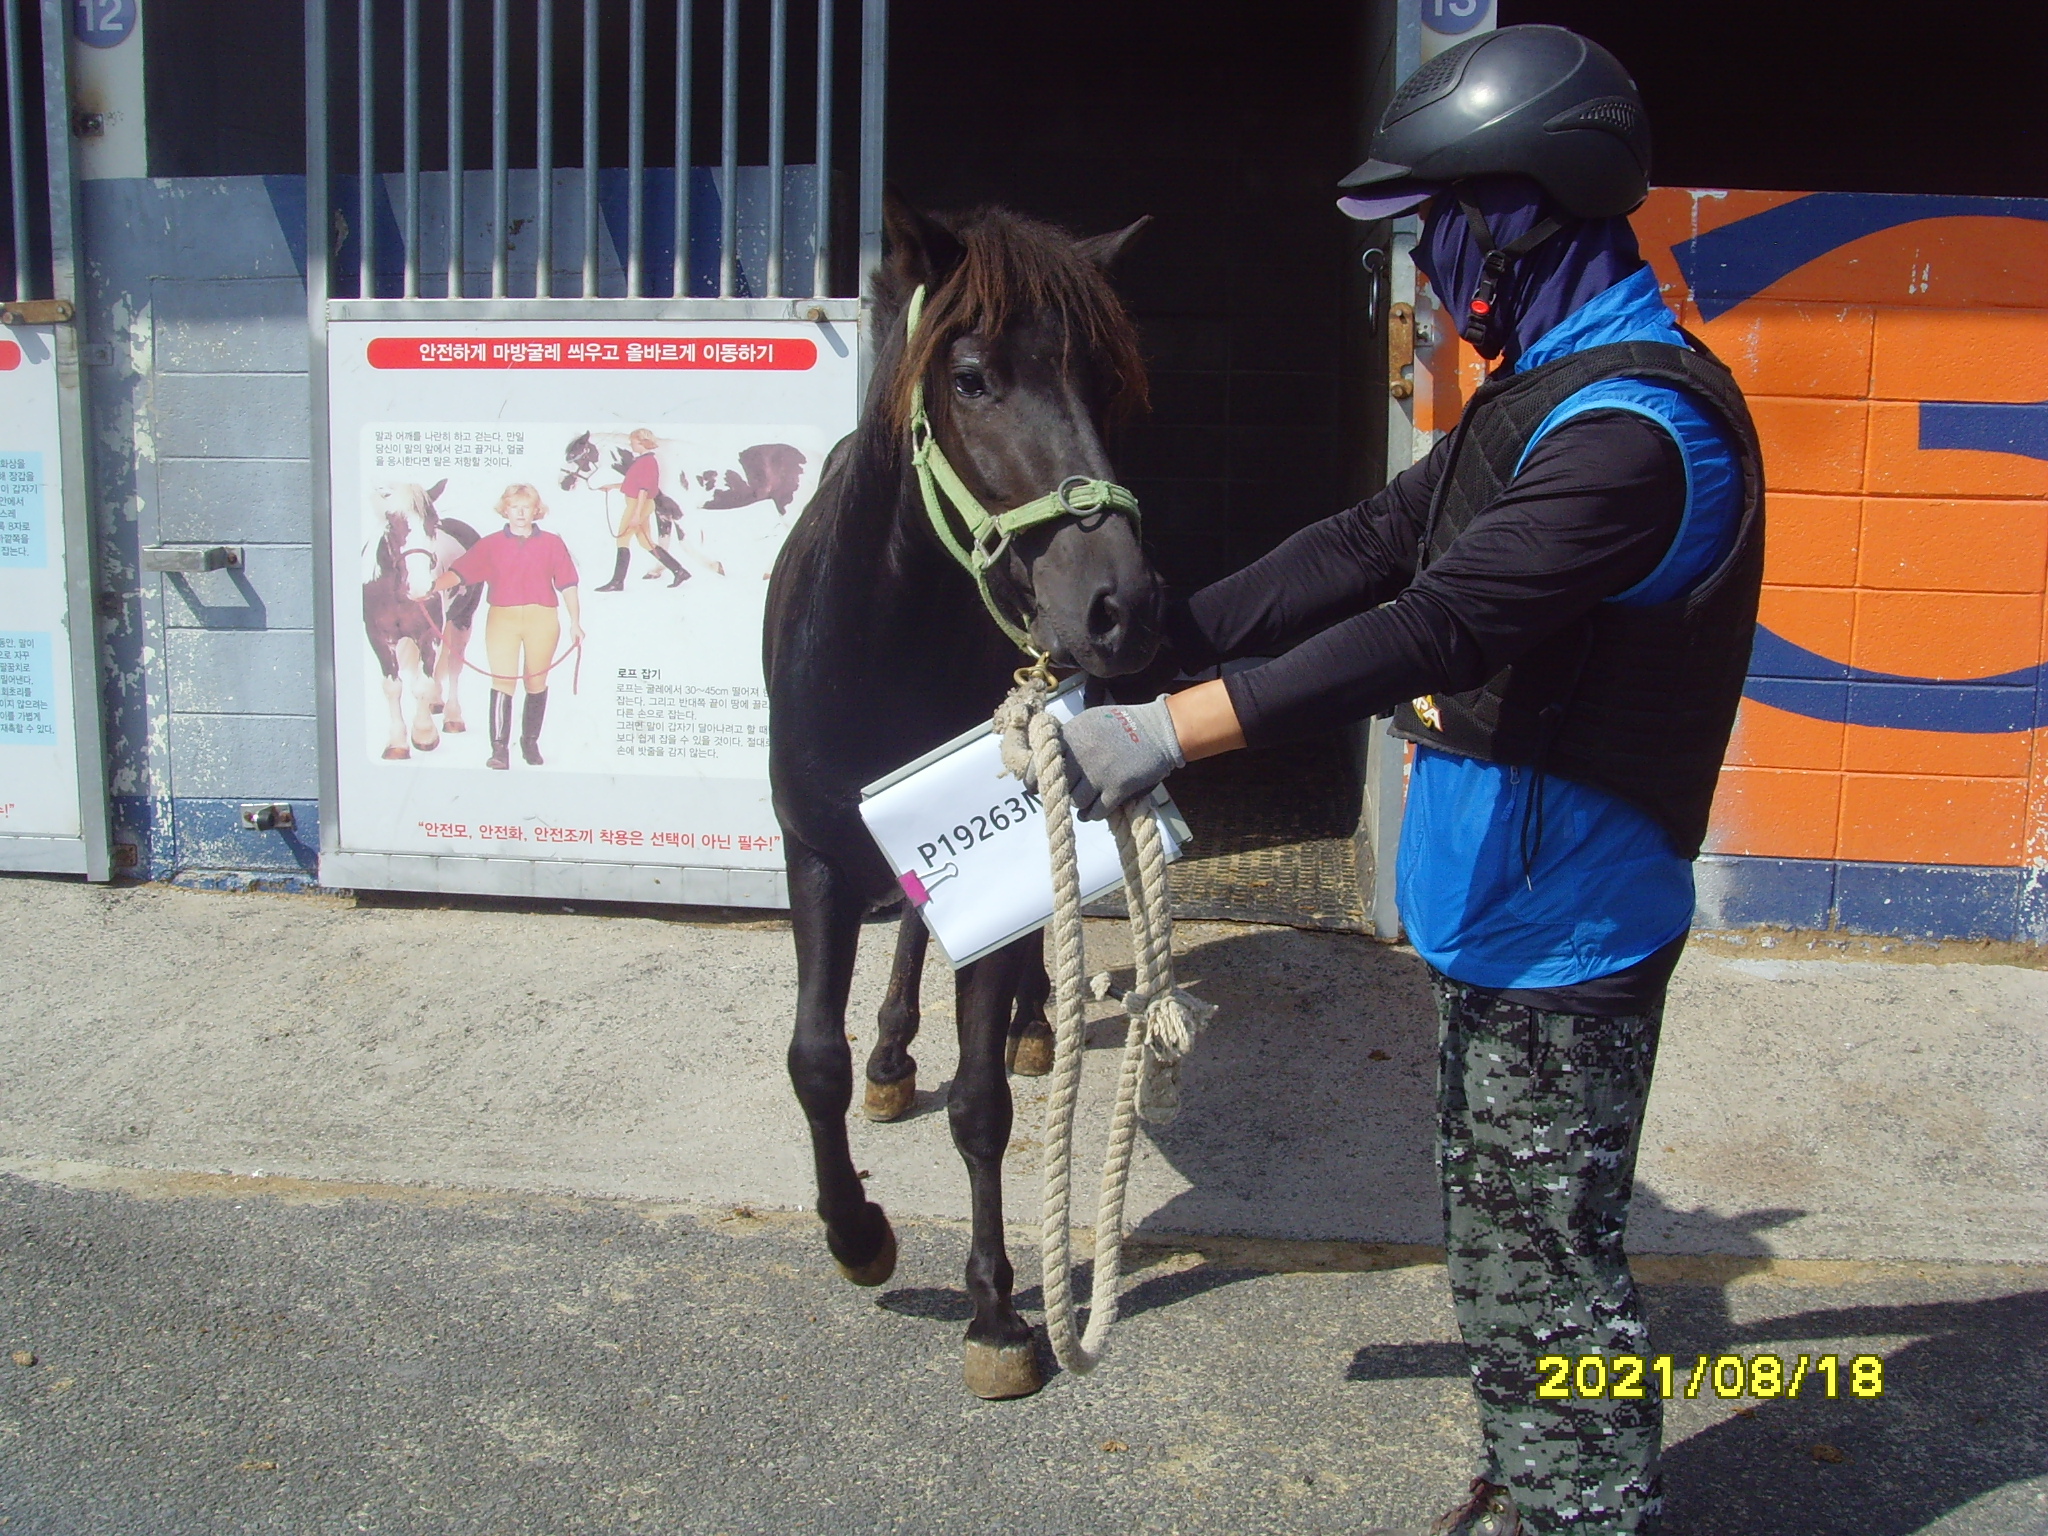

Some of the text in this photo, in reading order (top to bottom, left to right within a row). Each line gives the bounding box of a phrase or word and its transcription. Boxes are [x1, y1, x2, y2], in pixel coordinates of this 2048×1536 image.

[79, 0, 123, 31] 12
[419, 343, 774, 362] 안전하게 마방굴레 씌우고 올바르게 이동하기
[375, 431, 392, 441] 말과
[396, 431, 421, 441] 어깨를
[425, 431, 450, 441] 나란히
[454, 431, 471, 441] 하고
[506, 431, 524, 441] 만일
[375, 444, 401, 454] 당신이
[404, 444, 422, 454] 말의
[425, 444, 450, 454] 앞에서
[454, 444, 471, 454] 걷고
[506, 444, 524, 454] 얼굴
[376, 456, 512, 466] 을 응시한다면 말은 저항할 것이다.
[9, 472, 34, 481] 장갑을
[12, 484, 37, 494] 갑자기
[19, 638, 34, 648] 말이
[14, 651, 29, 660] 자꾸
[618, 668, 661, 680] 로프 잡기
[1, 687, 32, 697] 회초리를
[616, 683, 643, 693] 로프는
[646, 684, 682, 695] 굴레에서
[732, 687, 759, 696] 떨어져
[17, 700, 48, 710] 않으려는
[616, 696, 645, 706] 잡는다.
[649, 697, 675, 706] 그리고
[679, 697, 706, 708] 반대쪽
[709, 698, 727, 708] 끝이
[731, 700, 748, 709] 땅에
[18, 712, 41, 722] 가볍게
[616, 708, 696, 720] 다른 손으로 잡는다.
[26, 724, 34, 734] 수
[36, 724, 55, 734] 있다.
[617, 721, 643, 731] 그러면
[646, 722, 664, 732] 말이
[668, 722, 694, 732] 갑자기
[698, 723, 743, 734] 달아나려고
[747, 725, 755, 734] 할
[617, 733, 634, 743] 보다
[638, 734, 655, 743] 쉽게
[659, 734, 676, 744] 잡을
[680, 735, 689, 745] 수
[692, 736, 710, 746] 있을
[714, 737, 743, 747] 것이다.
[617, 745, 634, 755] 손에
[638, 746, 664, 756] 밧줄을
[689, 748, 718, 759] 않는다.
[479, 824, 528, 842] 안전화,
[534, 826, 593, 844] 안전조끼
[600, 829, 644, 846] 착용은
[650, 832, 695, 848] 선택이
[701, 834, 730, 850] 아닌
